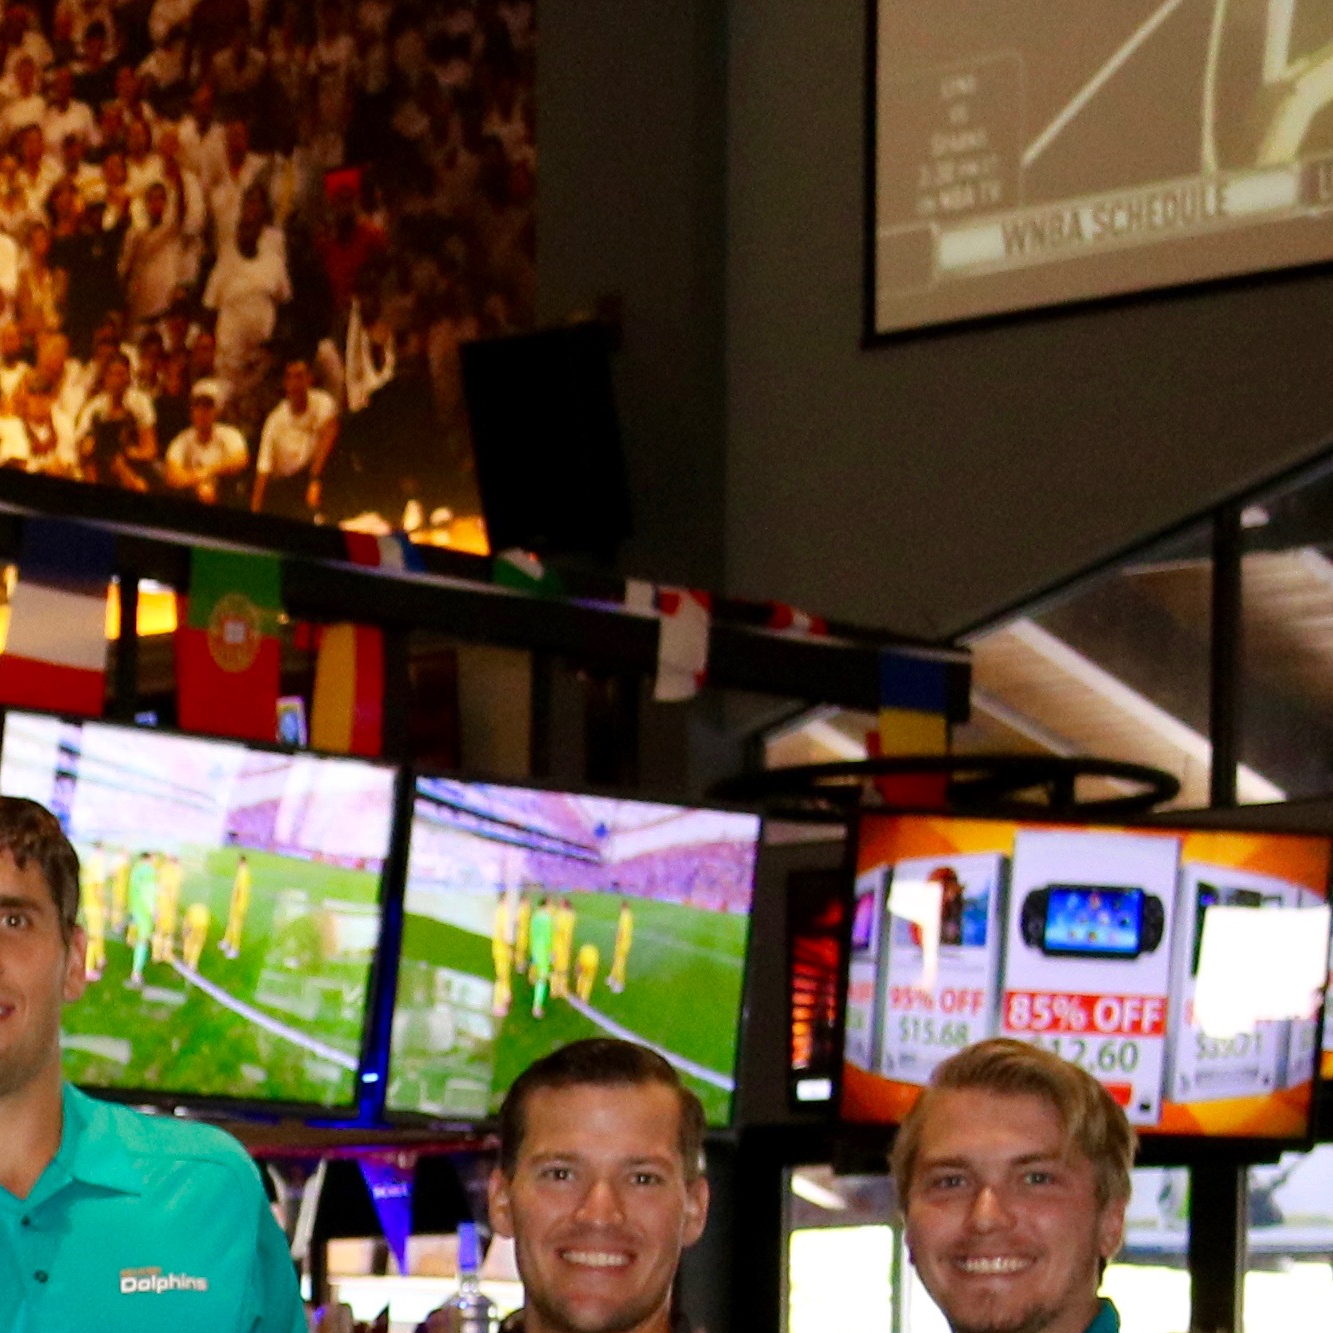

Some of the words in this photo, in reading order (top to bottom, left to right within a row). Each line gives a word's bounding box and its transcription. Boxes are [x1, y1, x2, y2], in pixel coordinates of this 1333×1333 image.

[1001, 207, 1087, 256] WNBA
[1091, 180, 1230, 239] SCHEDULE
[940, 987, 984, 1016] OFF
[1007, 993, 1087, 1030] 85%
[1093, 998, 1165, 1034] OFF
[119, 1272, 209, 1295] Dolphins
